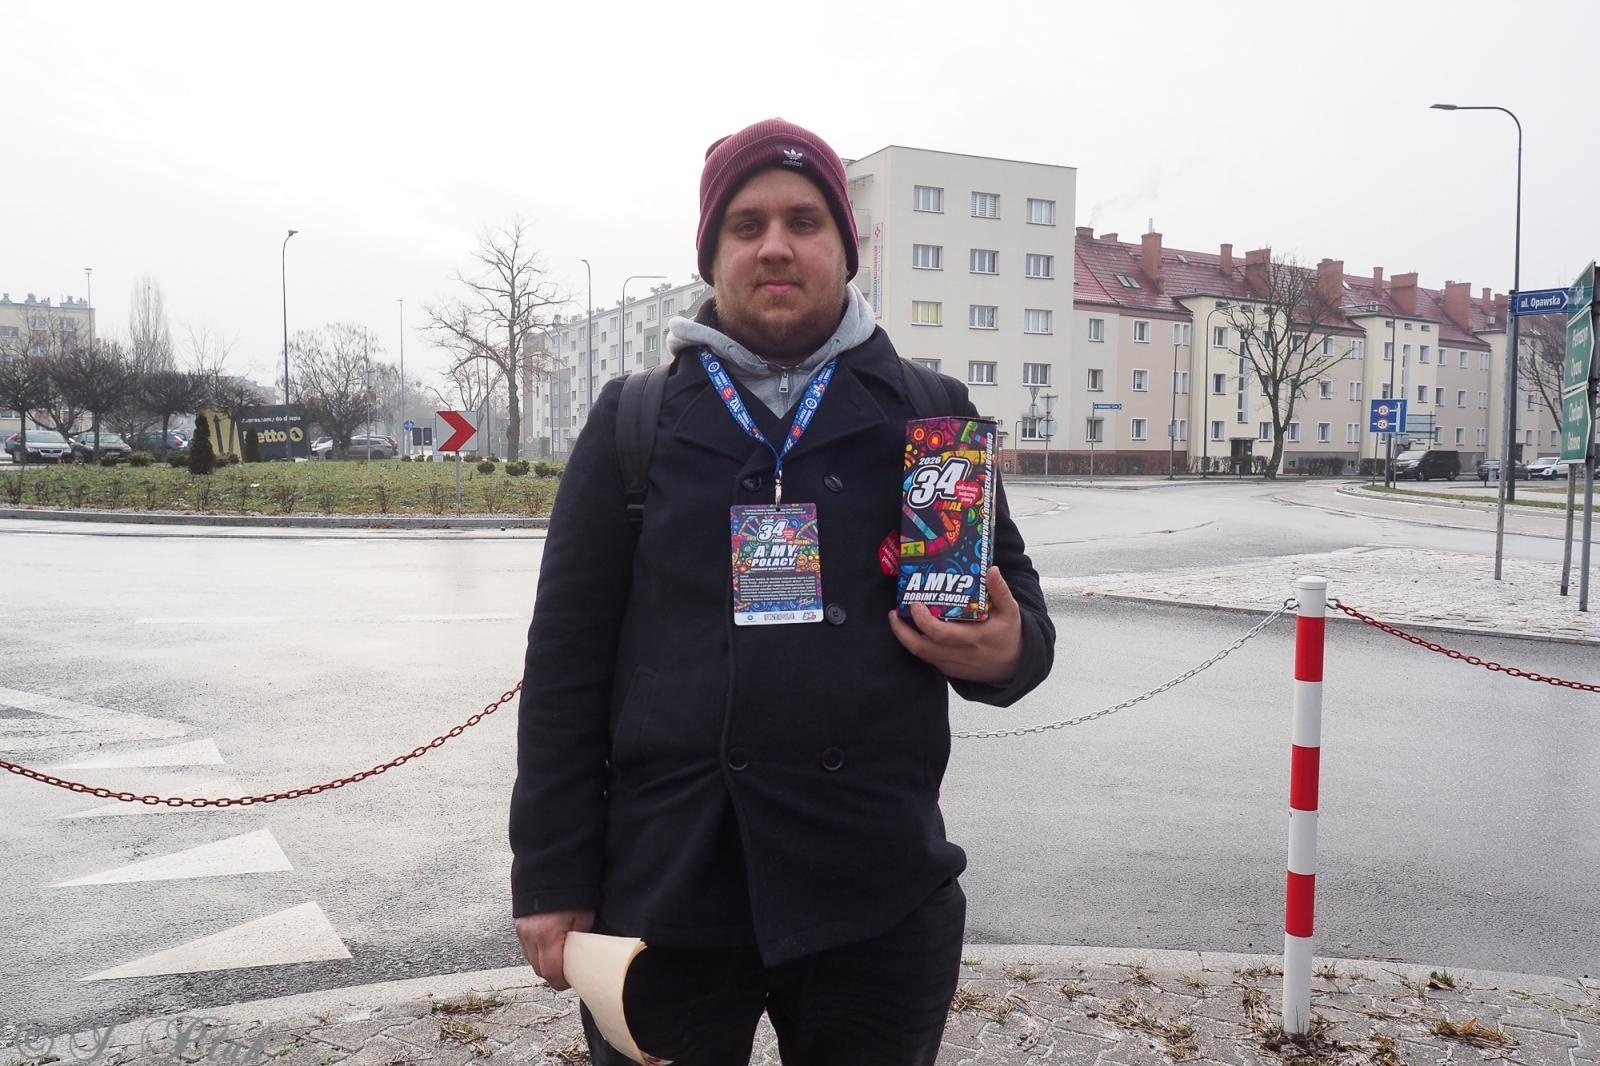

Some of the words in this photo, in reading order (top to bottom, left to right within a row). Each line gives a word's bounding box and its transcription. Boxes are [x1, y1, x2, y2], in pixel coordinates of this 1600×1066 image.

[1521, 298, 1529, 308] ul.
[1530, 296, 1560, 309] Opawska
[919, 457, 941, 465] 2026
[985, 432, 994, 469] CHOROBY
[910, 461, 967, 506] 34
[983, 470, 992, 513] PRZEWODU
[758, 520, 787, 541] 34
[754, 545, 766, 558] A
[980, 514, 989, 575] POKARMOWEGO
[906, 572, 922, 591] A
[924, 572, 974, 593] MY?
[903, 592, 938, 601] ROBIMY
[938, 593, 971, 604] SWOJE
[978, 585, 986, 610] DZIECI
